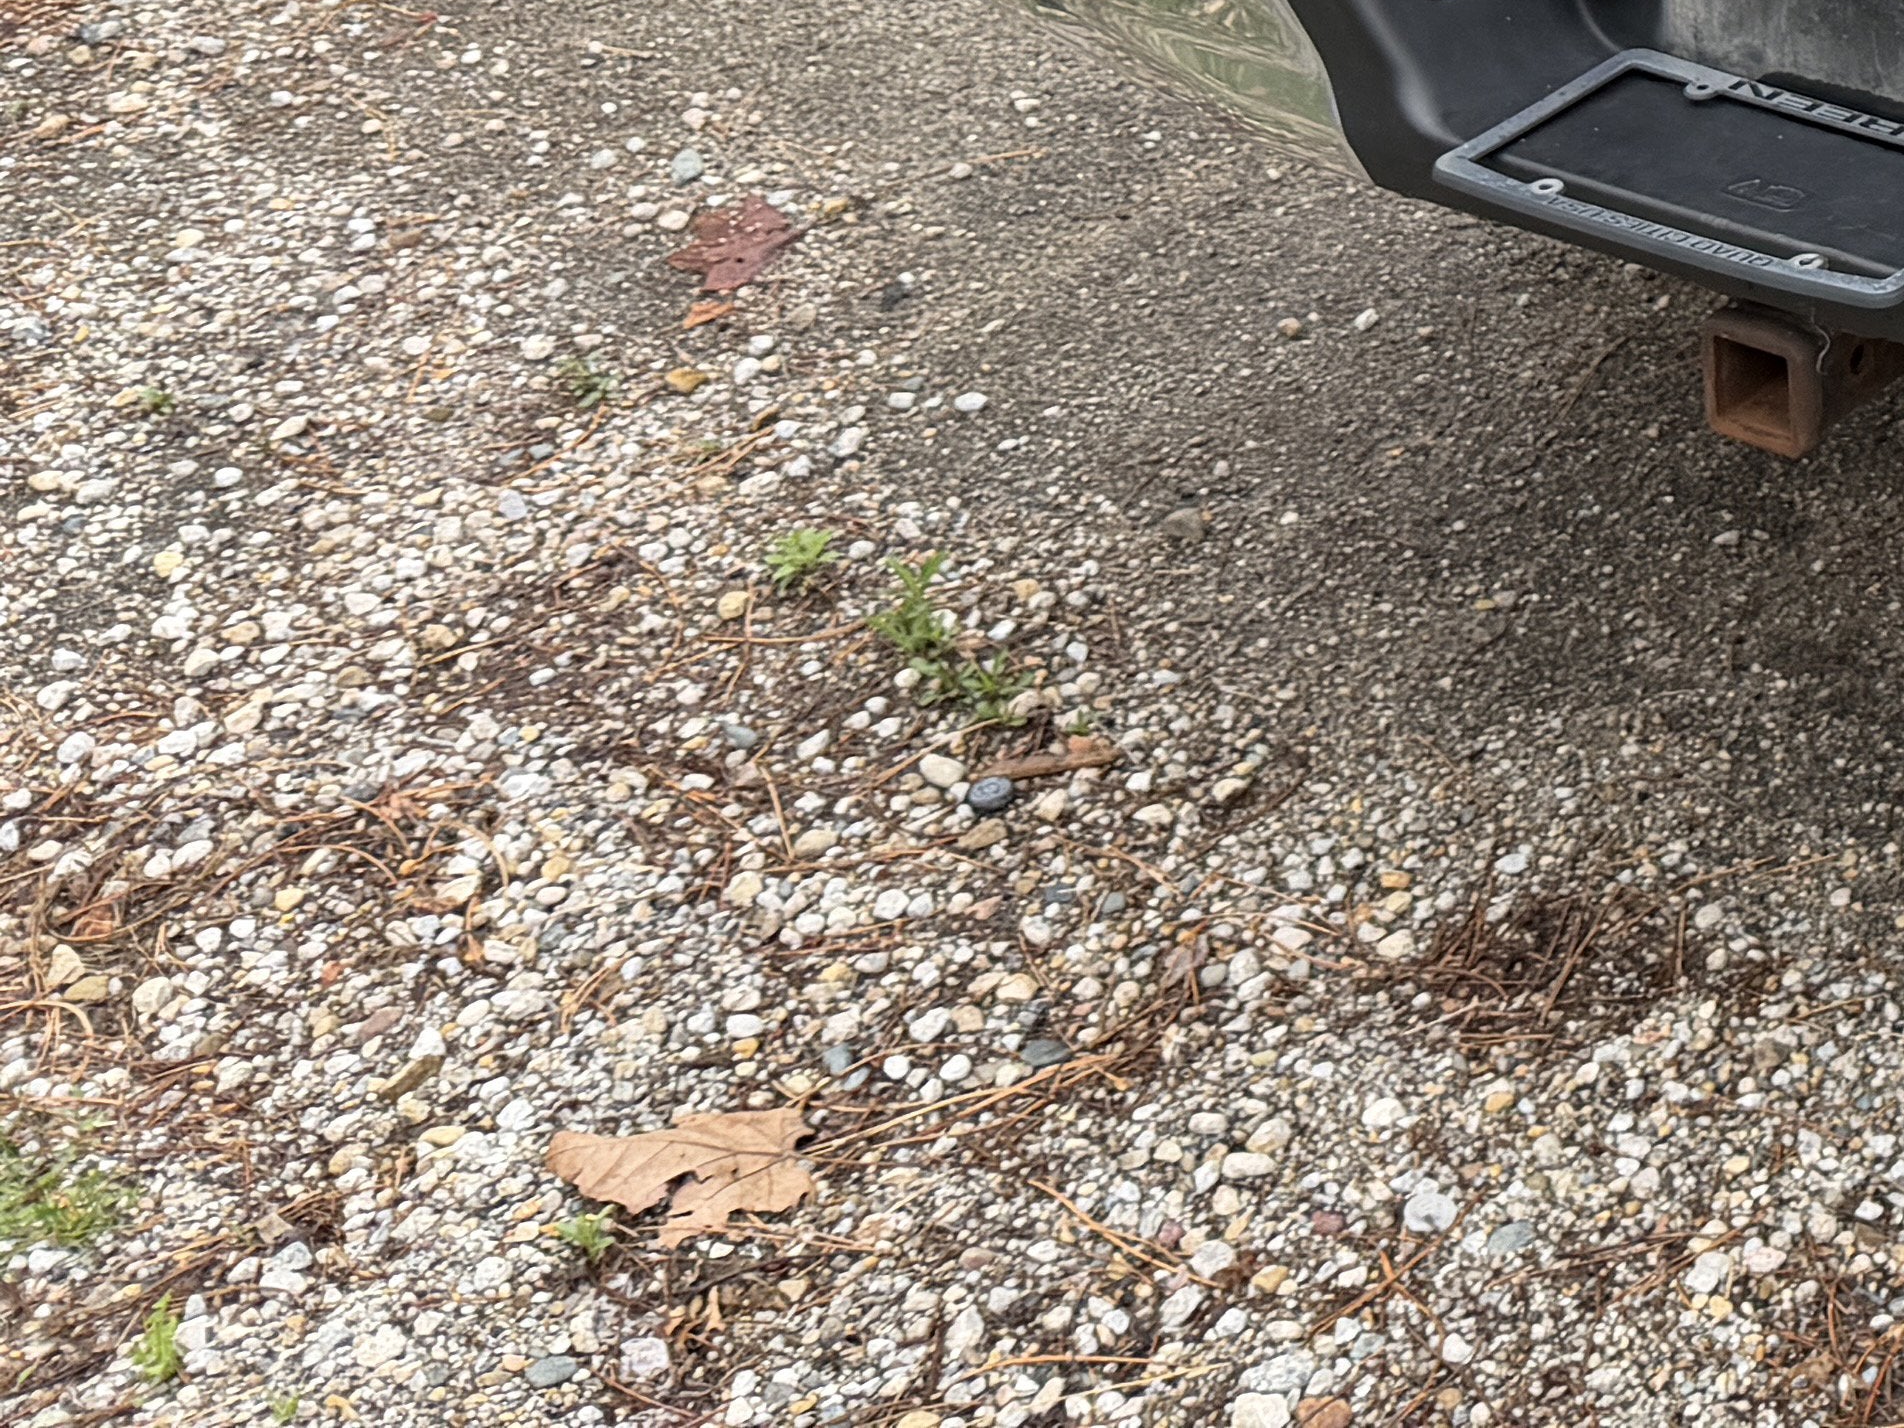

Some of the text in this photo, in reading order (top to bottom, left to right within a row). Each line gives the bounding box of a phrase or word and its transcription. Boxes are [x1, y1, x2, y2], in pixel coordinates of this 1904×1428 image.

[1548, 197, 1774, 267] QUAD CITIES USA
